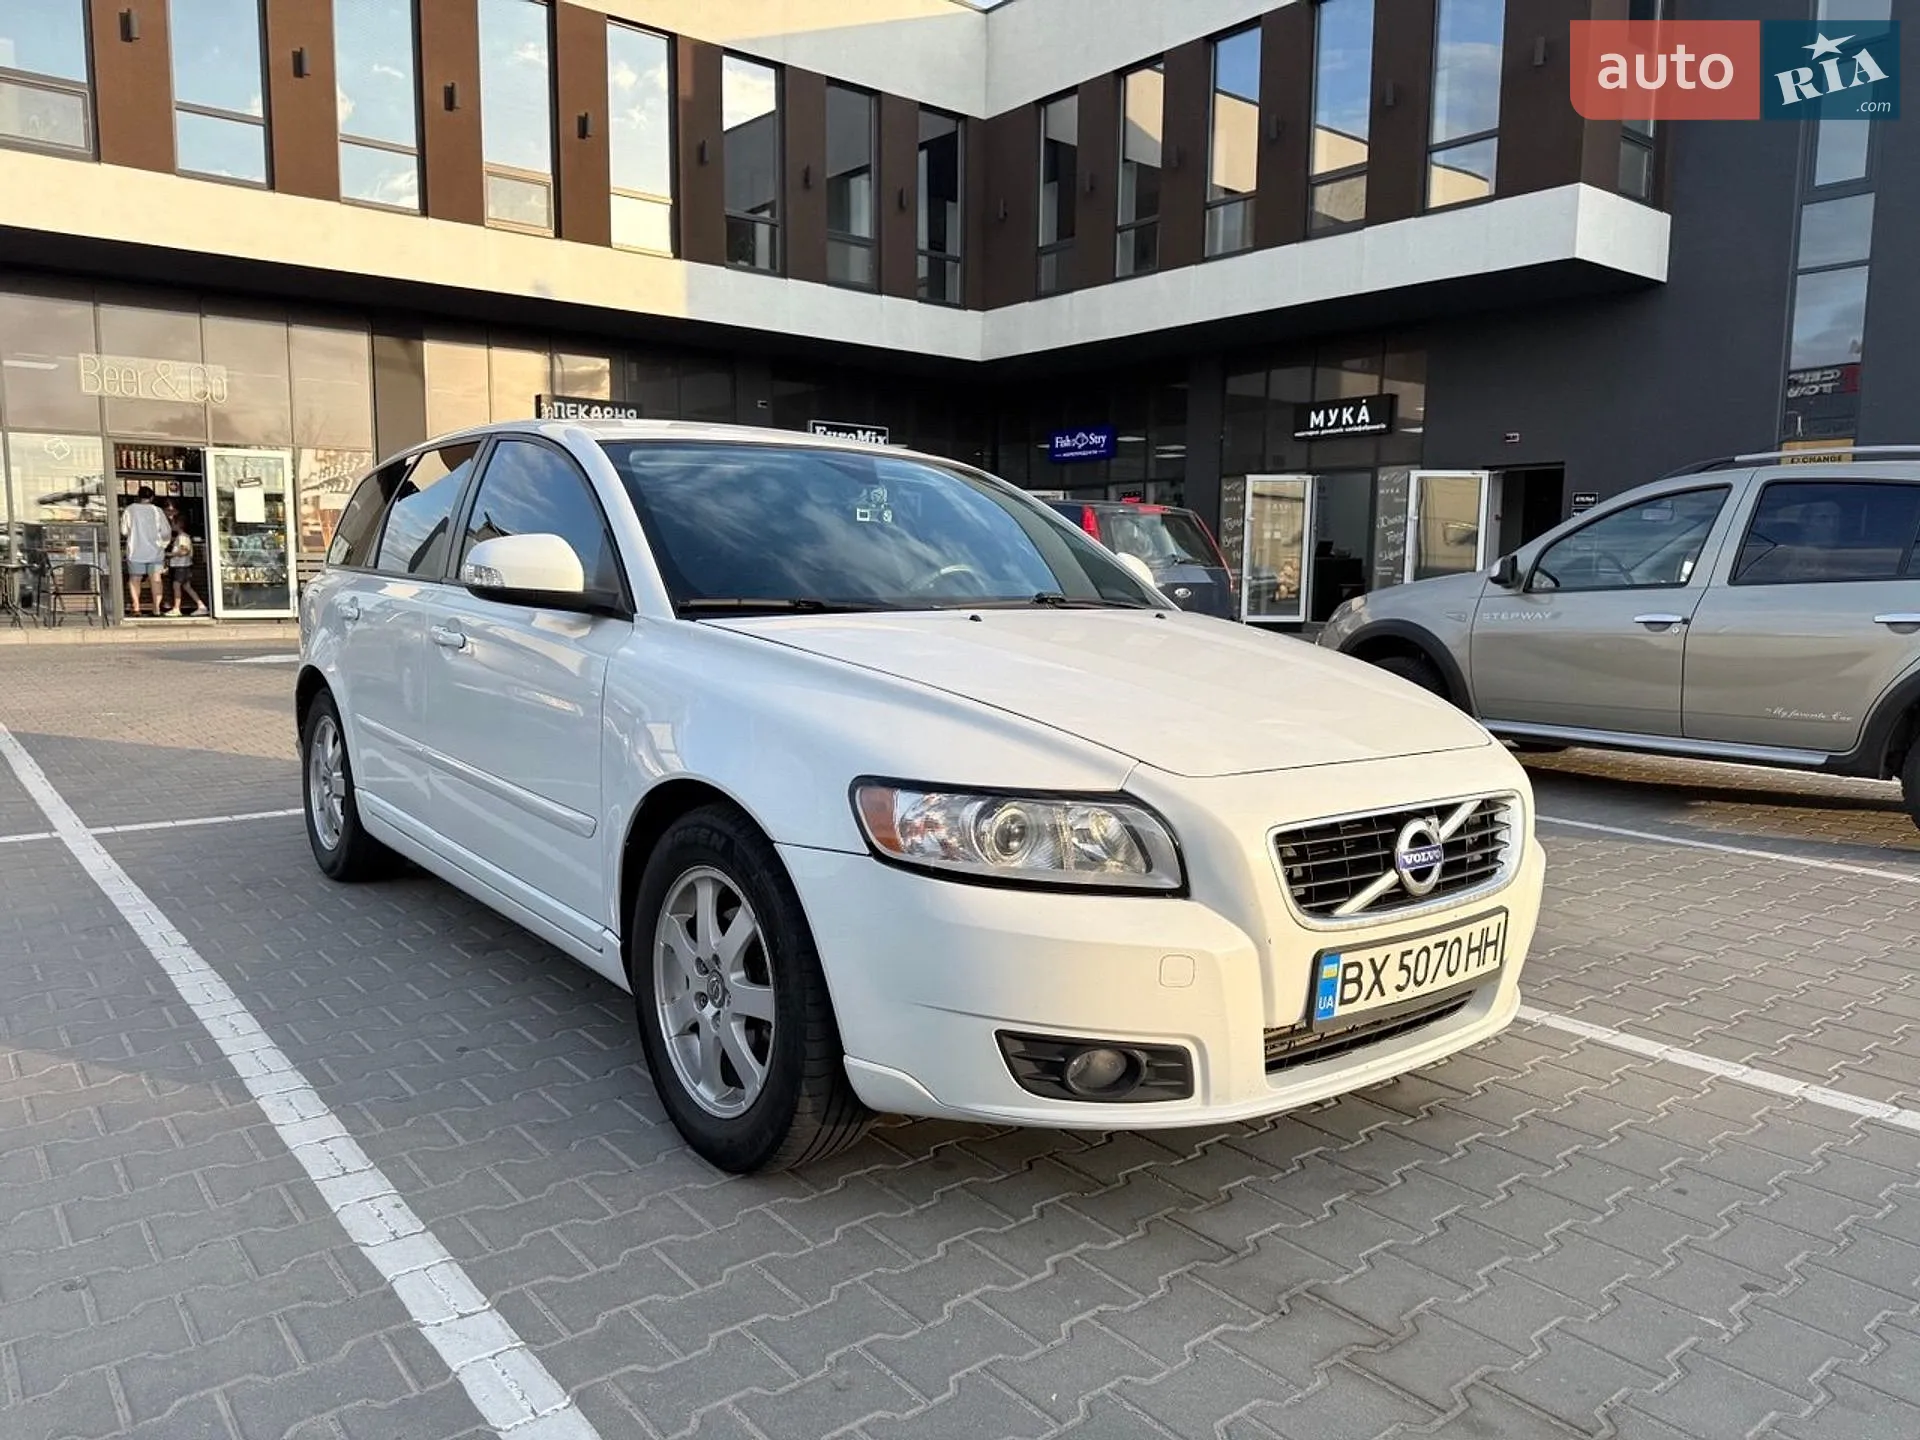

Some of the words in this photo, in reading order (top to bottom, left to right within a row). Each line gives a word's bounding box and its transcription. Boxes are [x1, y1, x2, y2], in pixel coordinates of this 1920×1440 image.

[80, 354, 147, 397] Beer
[152, 360, 184, 399] &
[1482, 611, 1552, 621] STEPWAY
[1403, 849, 1441, 865] VOLVO
[1338, 954, 1390, 1006] BX
[1394, 937, 1462, 993] 5070
[1464, 922, 1502, 973] HH
[1318, 996, 1334, 1010] UA
